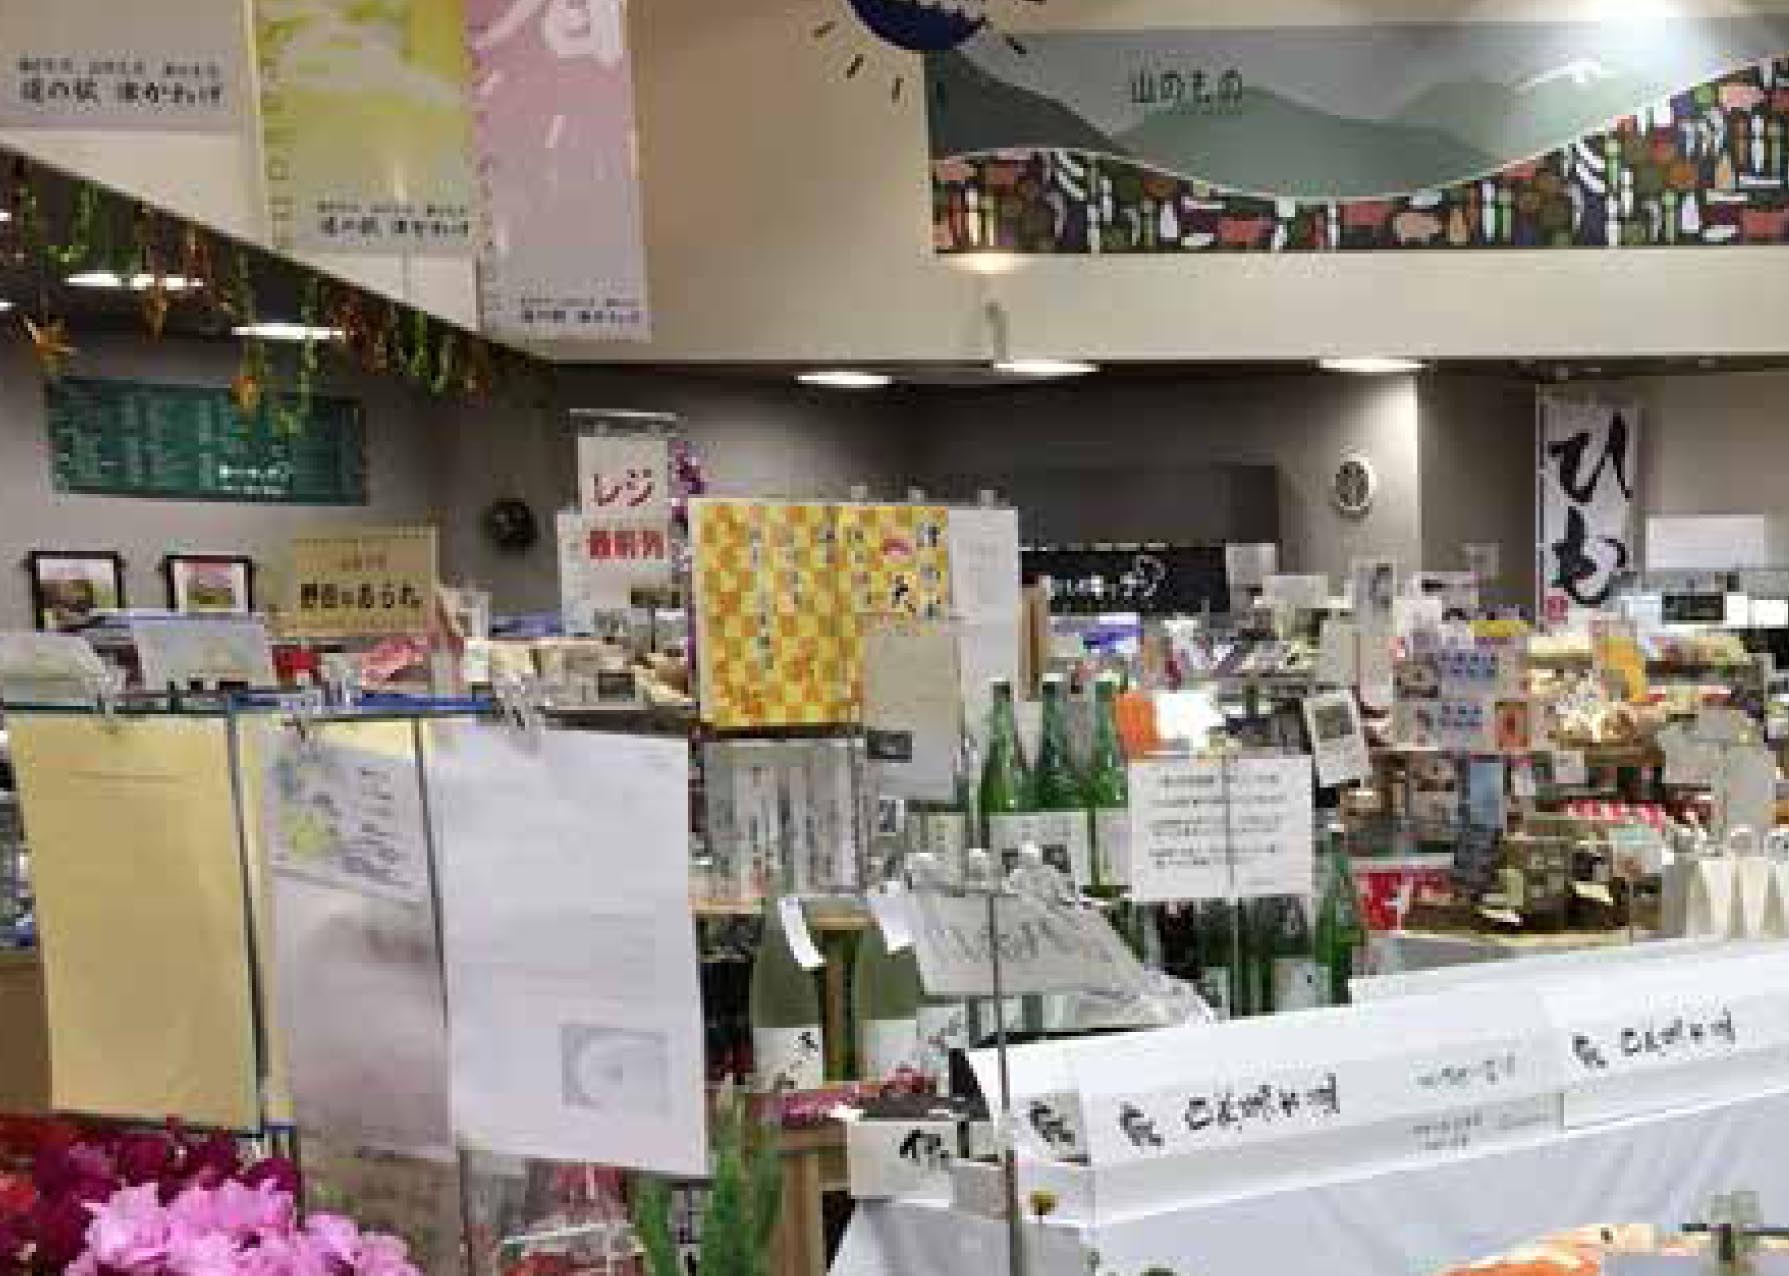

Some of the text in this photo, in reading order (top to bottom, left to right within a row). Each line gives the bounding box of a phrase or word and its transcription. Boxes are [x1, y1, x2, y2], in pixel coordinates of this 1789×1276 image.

[1131, 68, 1244, 106] 山のもの
[592, 468, 656, 507] レジ
